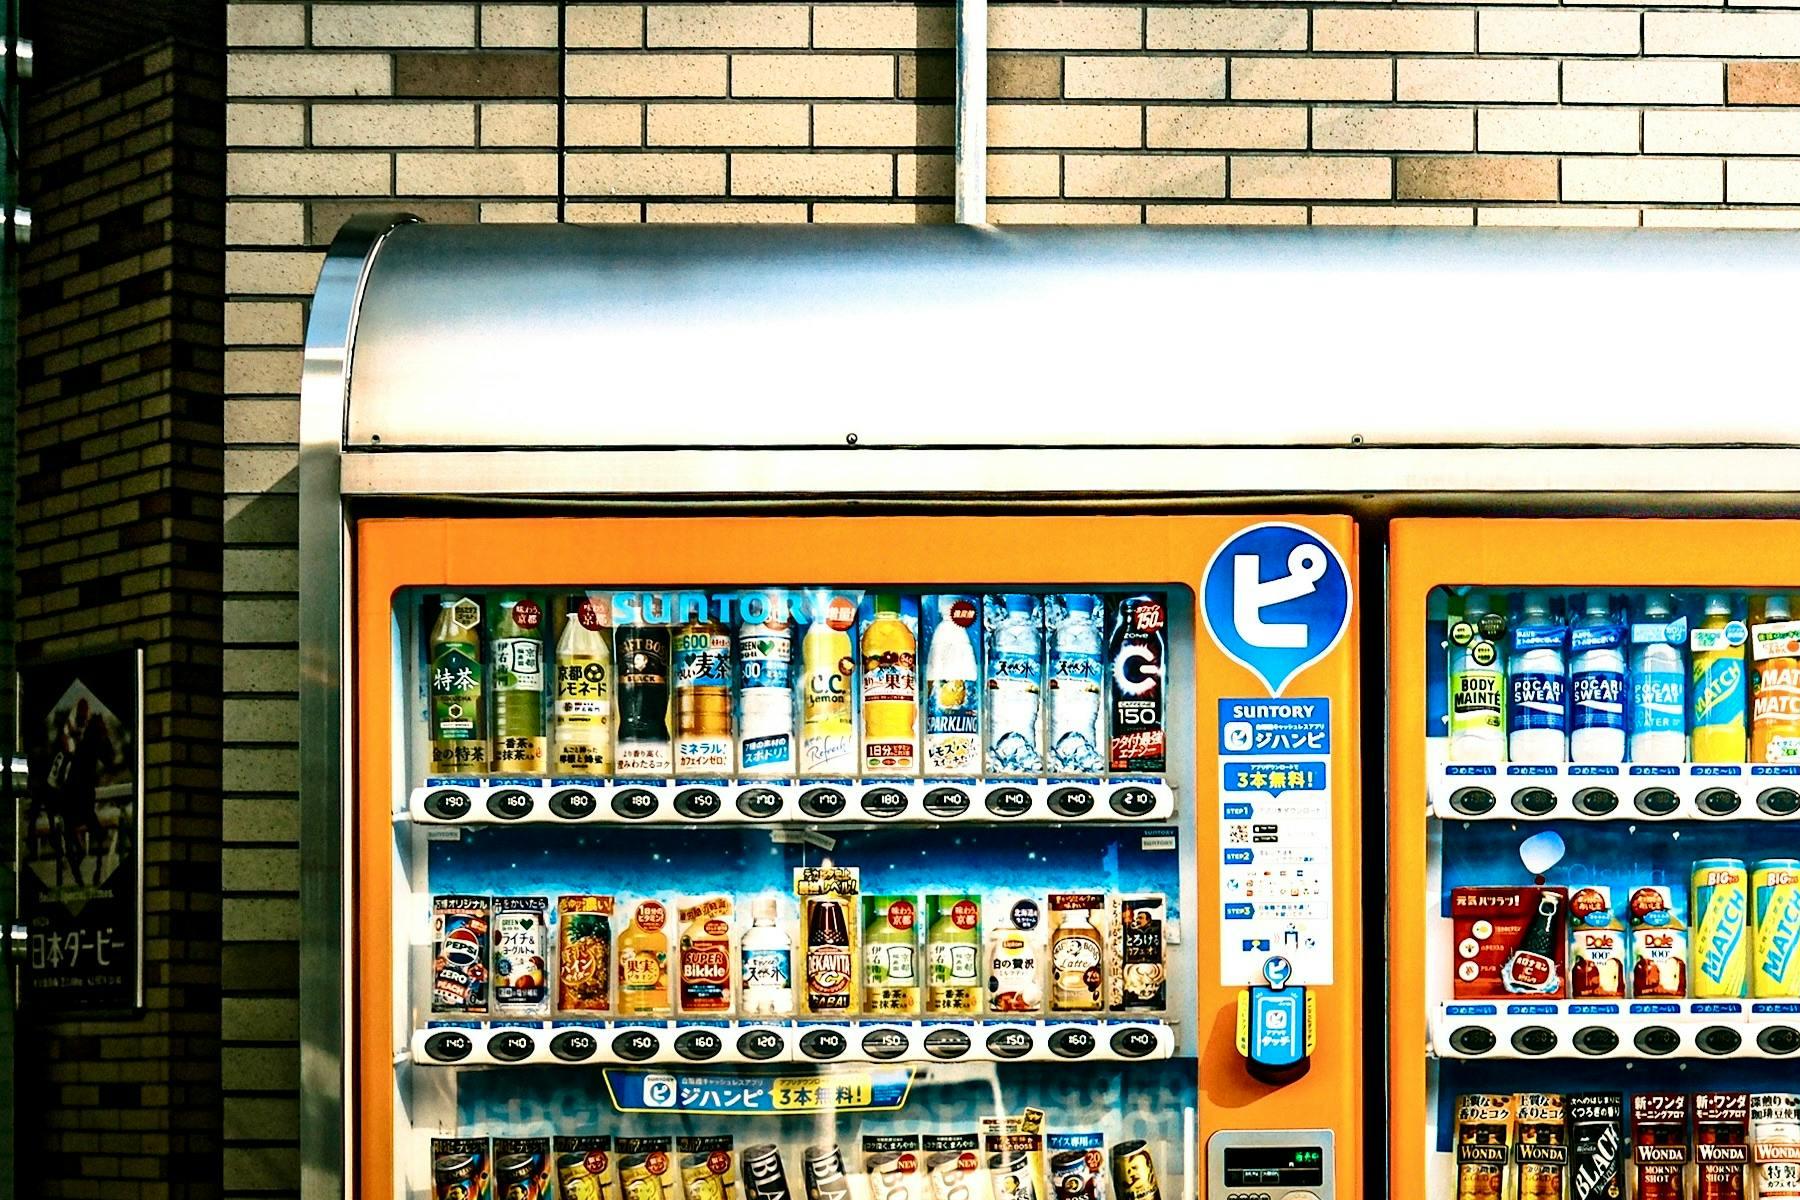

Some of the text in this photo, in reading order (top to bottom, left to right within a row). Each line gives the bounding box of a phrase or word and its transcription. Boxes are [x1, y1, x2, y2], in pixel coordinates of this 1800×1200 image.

[1233, 543, 1328, 648] ピ
[683, 635, 708, 649] 600
[695, 652, 731, 679] 麦茶
[434, 667, 479, 692] 特茶
[1461, 680, 1496, 693] BODY
[1574, 681, 1622, 692] POCARI
[558, 682, 607, 697] レモネード
[1513, 681, 1564, 693] POCARI
[1634, 682, 1683, 694] POCARI
[1694, 660, 1742, 715] MATCH
[1454, 691, 1501, 707] MAINTÉ
[1513, 691, 1562, 702] SWEAT
[1574, 690, 1619, 701] SWEAT
[1634, 692, 1679, 703] SWEAT
[1118, 708, 1156, 724] 150
[1233, 705, 1315, 718] SUNTORY
[1255, 732, 1325, 749] ジハンピ
[1237, 771, 1313, 788] 3本無料!
[1707, 872, 1730, 886] BIG
[1766, 872, 1789, 886] BIG
[1457, 895, 1520, 907] 元気ハツラツ!
[1586, 934, 1615, 948] Dole
[1645, 934, 1674, 948] Dole
[1700, 889, 1745, 984] MATCH
[32, 929, 126, 969] 日本ダービー
[445, 940, 478, 955] PEPSI
[685, 952, 723, 964] SUPER
[439, 970, 467, 985] ZERO
[684, 963, 725, 979] Bikkle
[680, 1088, 763, 1108] ジハンピ
[779, 1085, 862, 1107] 3本無料!
[1459, 1108, 1509, 1120] 香りとコク
[1571, 1107, 1620, 1117] くつろぎの香り
[1461, 1146, 1503, 1160] WONDA
[1519, 1145, 1564, 1160] WONDA
[1638, 1145, 1684, 1161] WONDA
[1700, 1144, 1745, 1159] WONDA
[1757, 1145, 1800, 1159] WONDA
[898, 1159, 918, 1168] NEW
[957, 1158, 978, 1168] NEW
[1645, 1174, 1669, 1183] SHOT
[1705, 1174, 1730, 1182] SHOT
[1767, 1165, 1796, 1180] 特製
